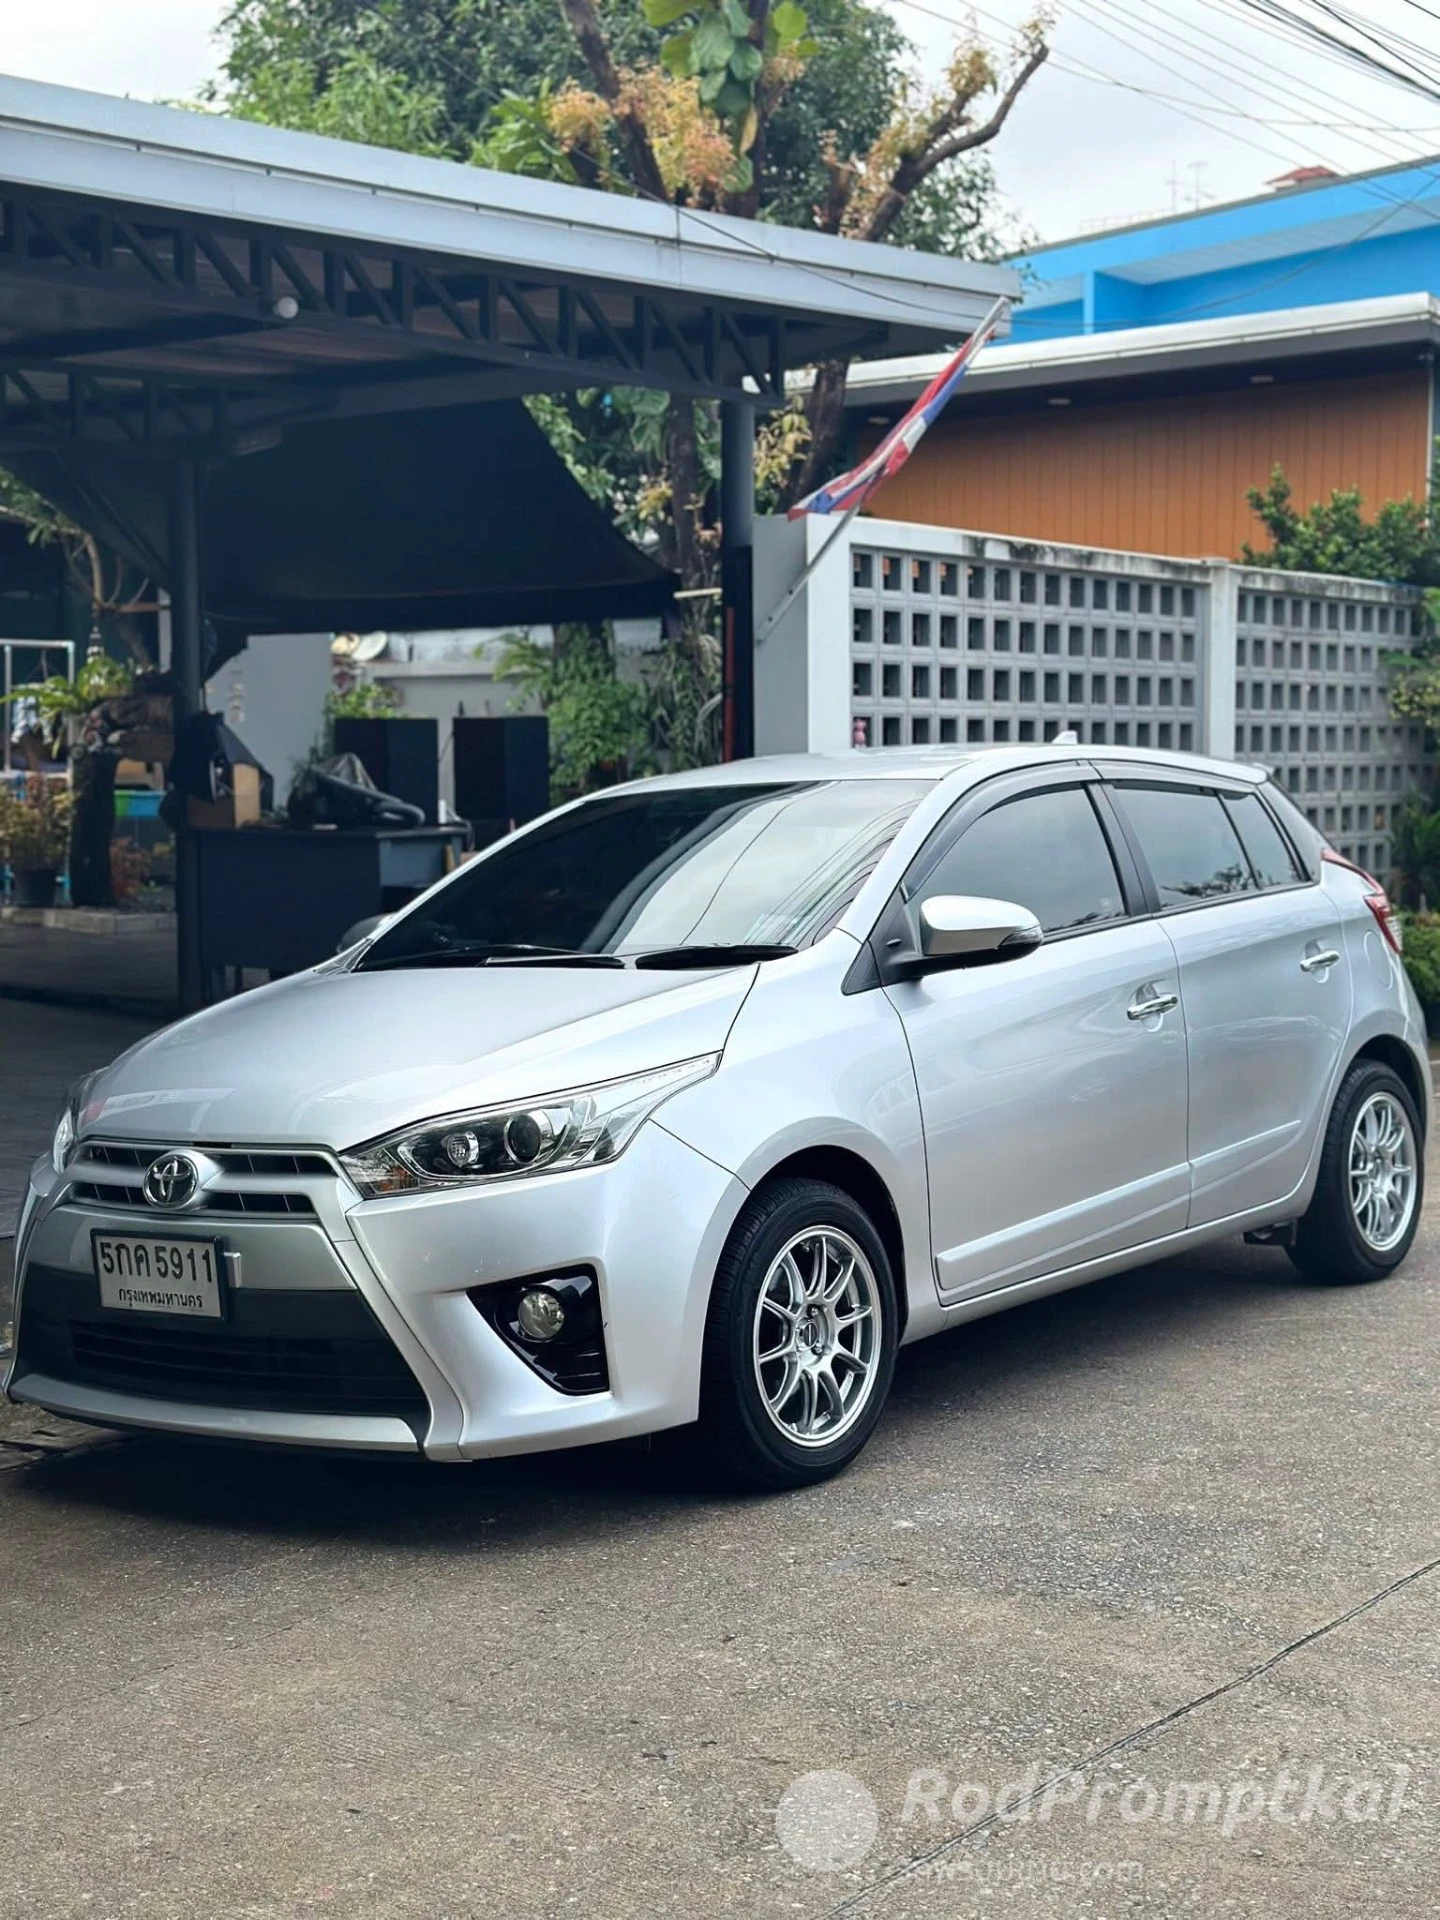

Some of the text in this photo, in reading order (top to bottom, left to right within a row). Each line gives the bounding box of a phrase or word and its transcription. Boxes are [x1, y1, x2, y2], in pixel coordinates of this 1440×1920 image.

[154, 1246, 212, 1282] 5911
[119, 1288, 202, 1308] กรุงเทพมหานคร
